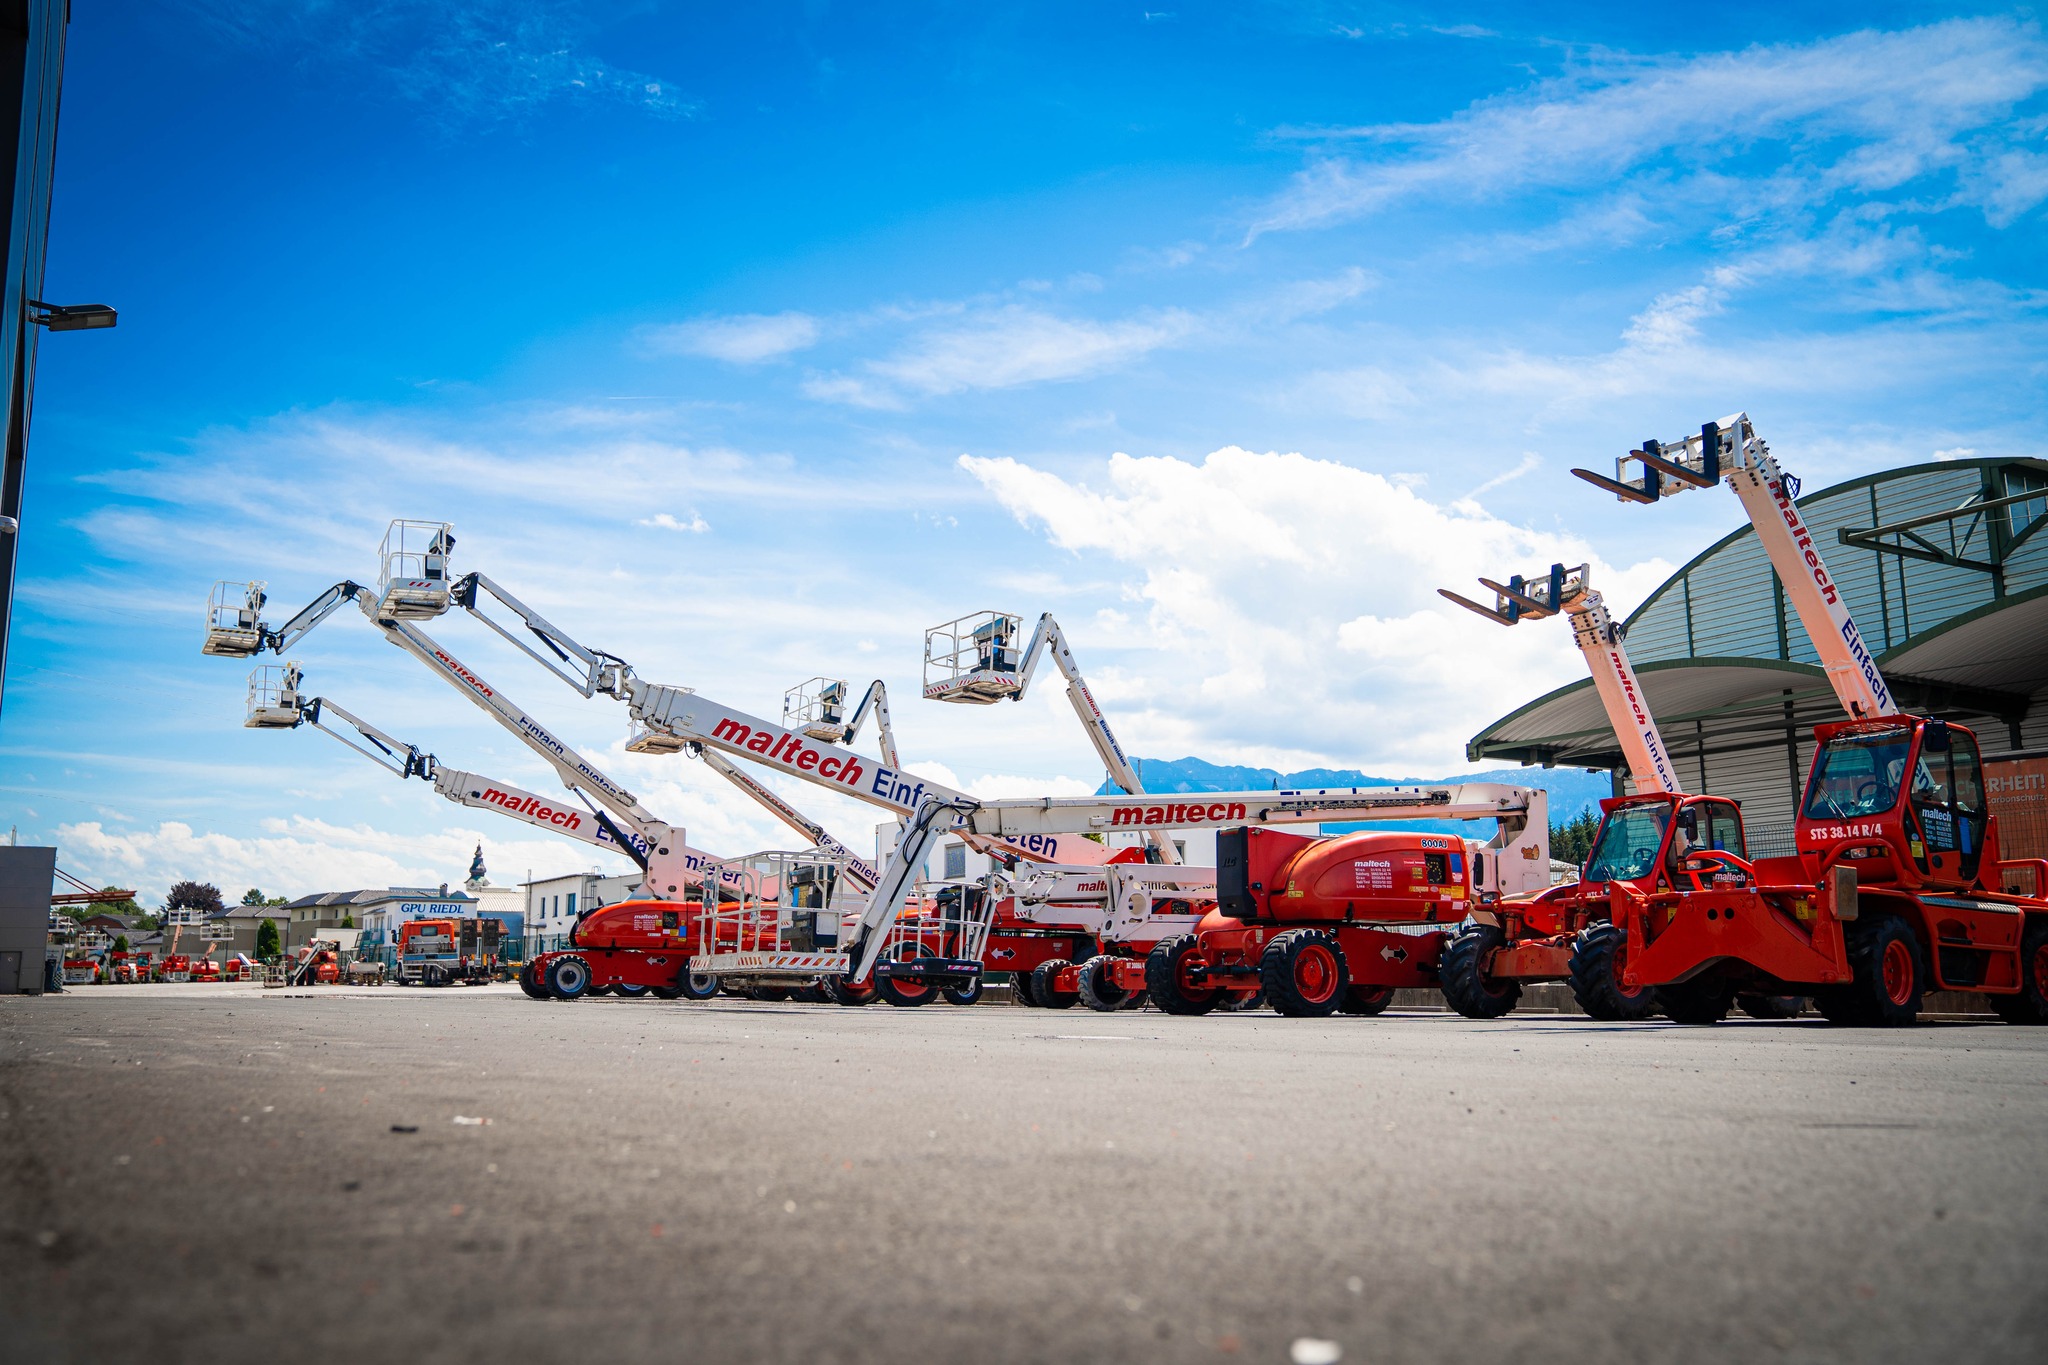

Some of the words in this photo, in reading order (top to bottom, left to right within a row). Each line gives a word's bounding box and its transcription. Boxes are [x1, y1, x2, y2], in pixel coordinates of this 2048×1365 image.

[1768, 481, 1837, 606] maltech
[1841, 617, 1887, 710] Einfach
[435, 650, 493, 697] maltech
[1081, 687, 1101, 717] maltech
[1099, 719, 1115, 745] Einfach
[1112, 744, 1127, 767] mieten
[1611, 652, 1646, 725] maltech
[1644, 731, 1675, 792] Einfach
[711, 717, 864, 786] maltech
[481, 788, 581, 830] maltech
[1111, 803, 1247, 826] maltech
[1922, 808, 1952, 822] maltech
[1421, 838, 1448, 849] 800AJ
[1810, 827, 1828, 840] STS
[1830, 825, 1859, 839] 38.14
[1861, 823, 1882, 837] R/4
[850, 858, 881, 885] miete
[1355, 860, 1390, 868] maltech
[1715, 871, 1746, 882] maltech
[401, 903, 426, 913] GPU
[429, 903, 464, 914] RIEDL
